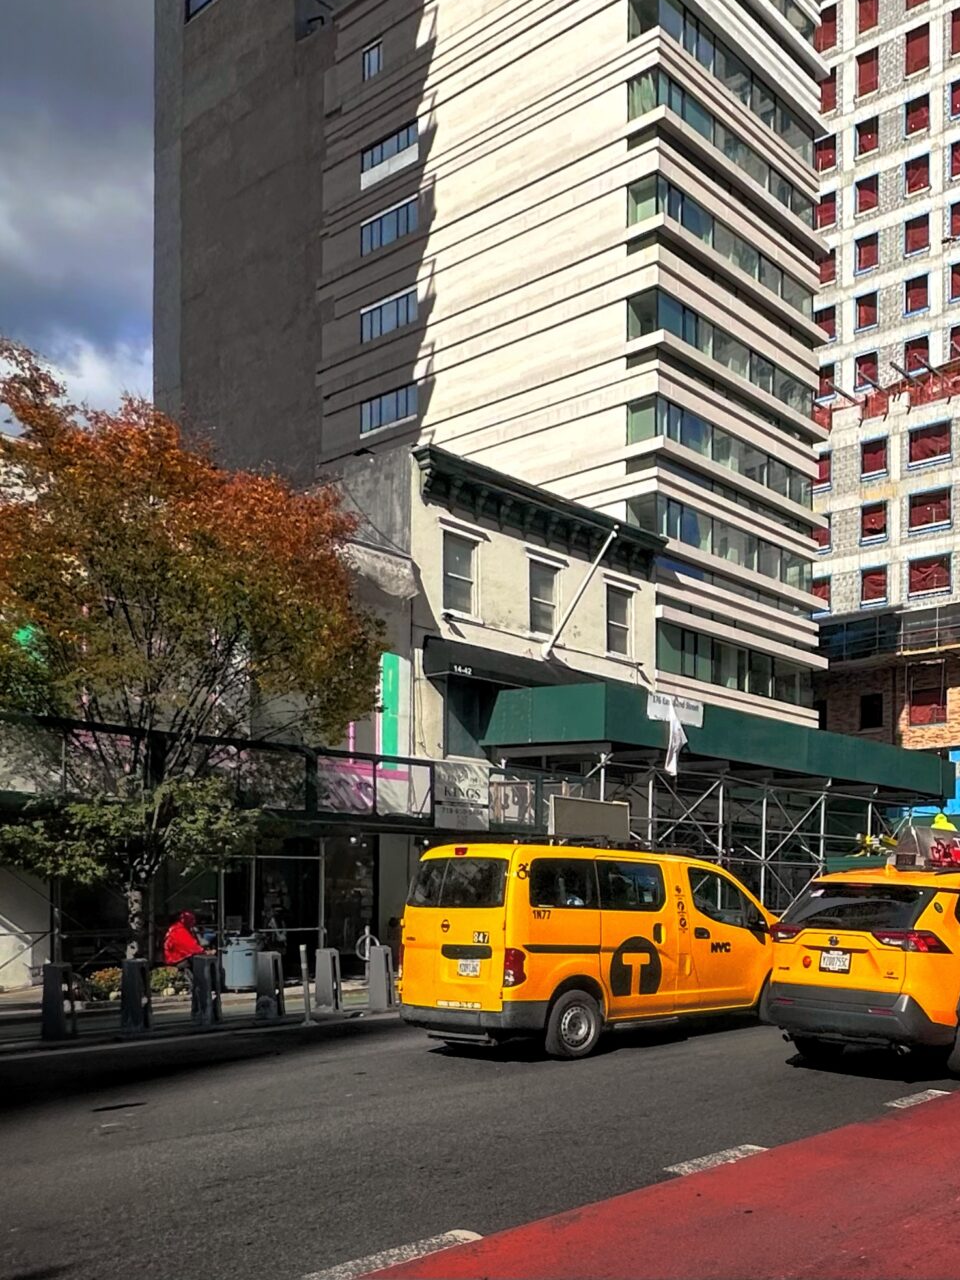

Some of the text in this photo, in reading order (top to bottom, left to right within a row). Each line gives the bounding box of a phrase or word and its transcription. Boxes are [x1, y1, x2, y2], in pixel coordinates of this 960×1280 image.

[444, 786, 481, 799] KINGS
[533, 910, 551, 920] 1N77
[473, 932, 489, 943] 847
[711, 942, 731, 953] NYC
